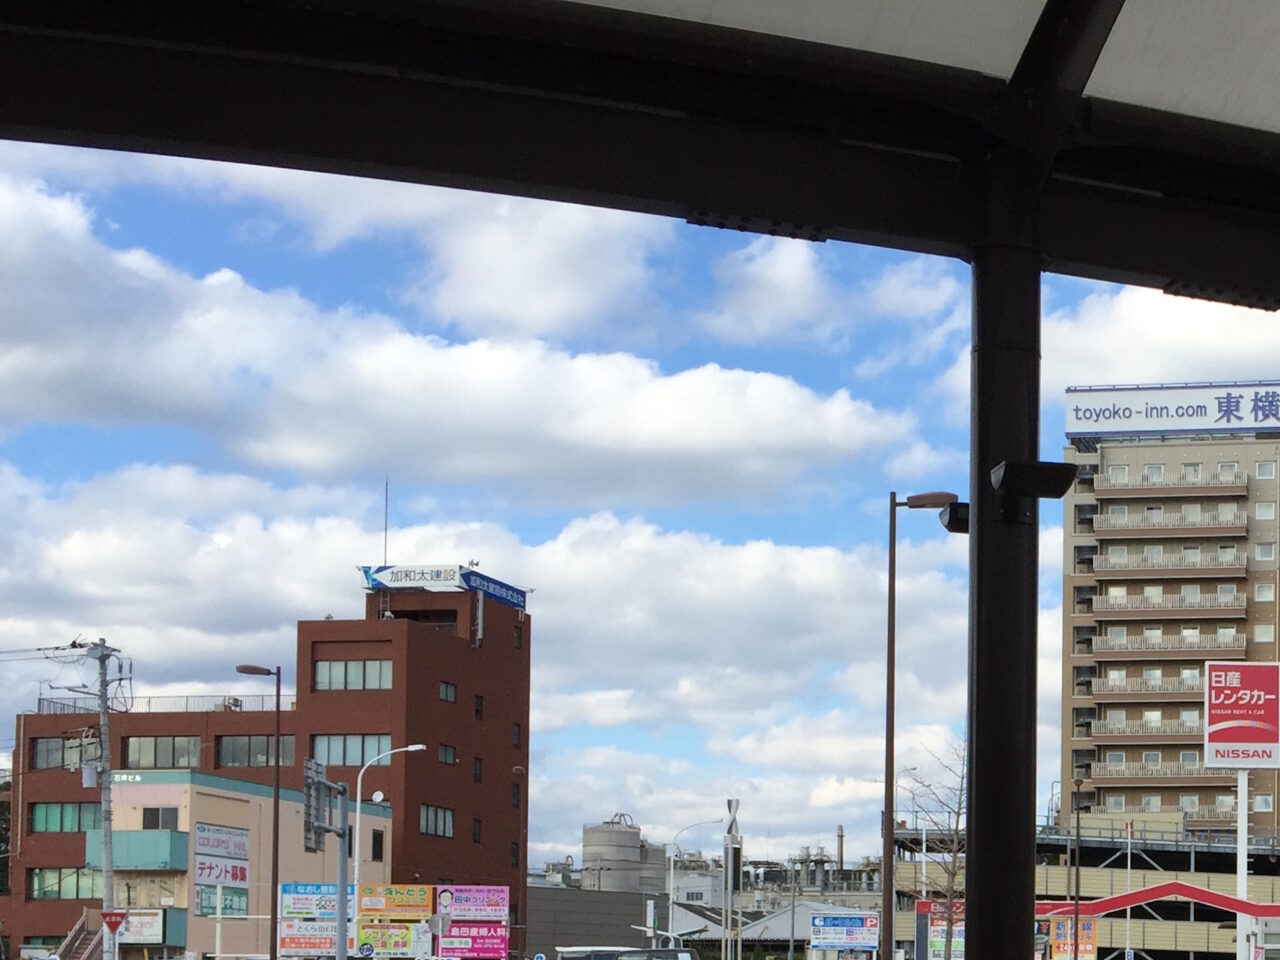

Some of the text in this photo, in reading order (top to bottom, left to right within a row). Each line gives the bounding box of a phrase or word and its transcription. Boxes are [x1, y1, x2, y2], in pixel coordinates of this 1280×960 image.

[1073, 402, 1208, 423] toyoko-inn.com
[390, 569, 457, 583] 加和太建設
[1211, 671, 1241, 688] 日産
[1211, 689, 1277, 705] レンタカー
[1215, 749, 1272, 759] NISSAN
[198, 861, 247, 882] テナント募集
[866, 918, 877, 927] P
